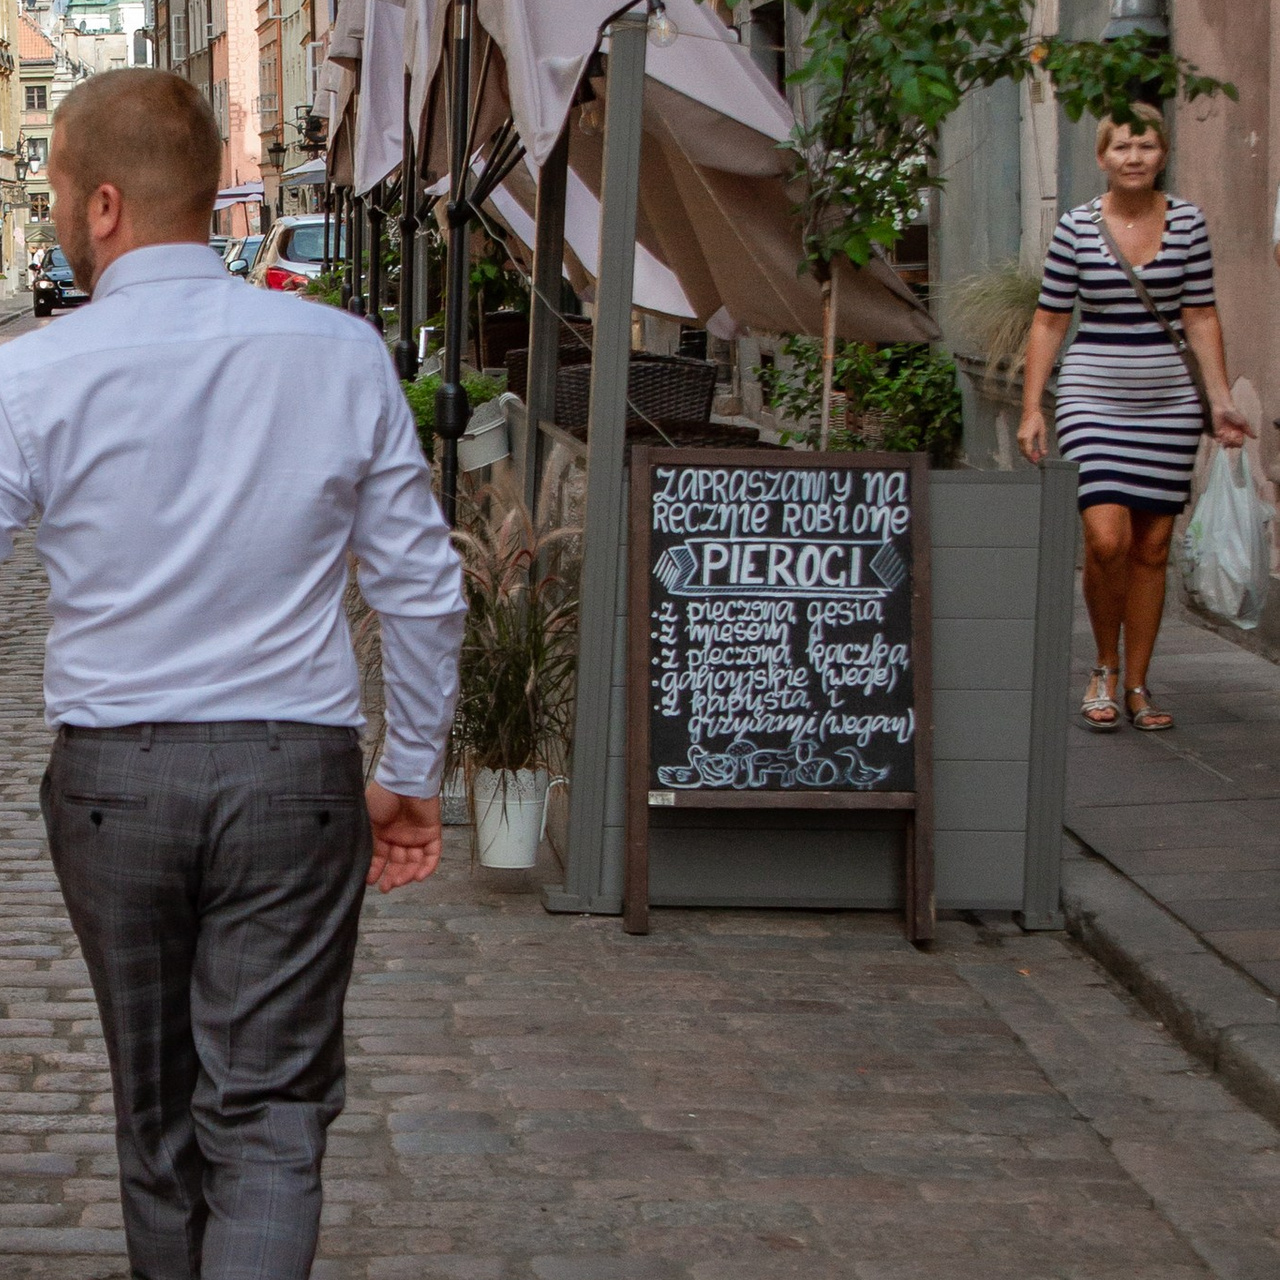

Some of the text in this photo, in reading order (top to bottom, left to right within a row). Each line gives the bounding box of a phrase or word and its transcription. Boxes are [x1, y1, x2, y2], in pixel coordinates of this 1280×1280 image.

[702, 543, 861, 588] PIEROGI
[684, 621, 789, 648] mięsem
[686, 598, 796, 628] pieczoną
[807, 599, 885, 640] gęsią
[685, 645, 793, 675] pieczoną
[805, 633, 910, 673] kaczką
[821, 664, 897, 695] (wege)
[689, 686, 812, 721] kapustą
